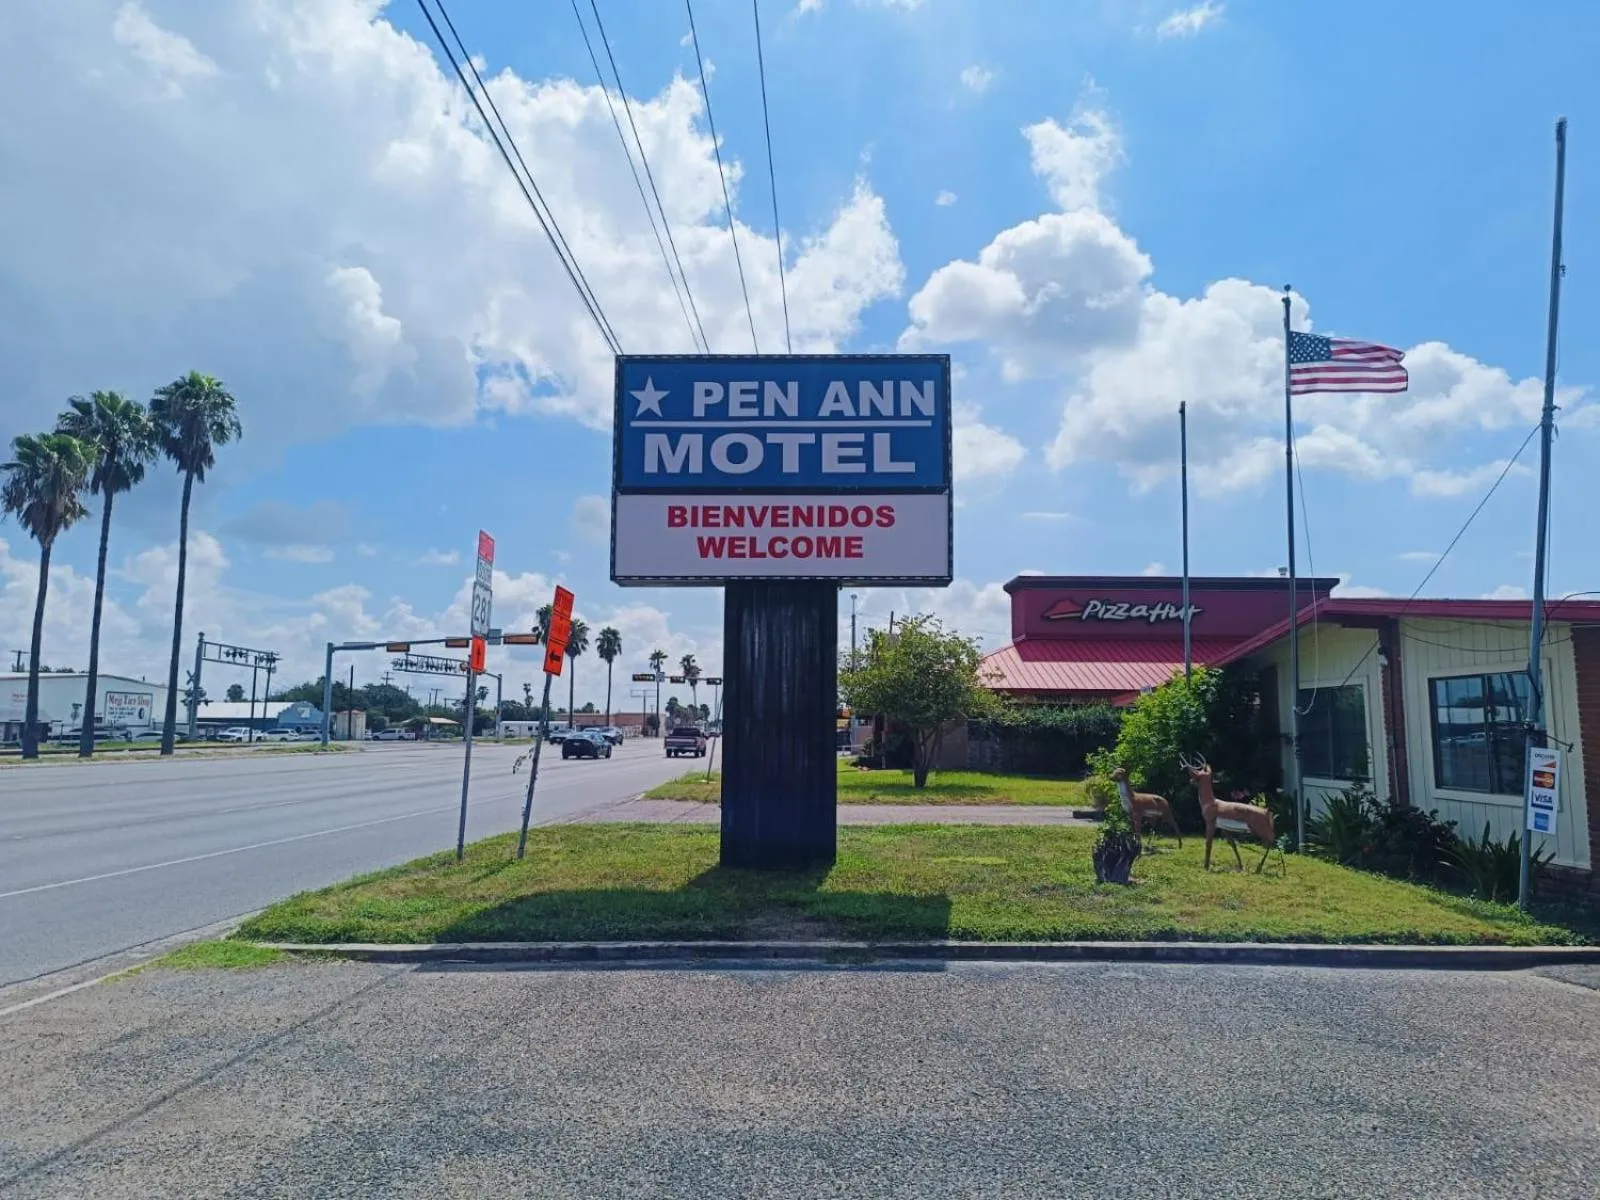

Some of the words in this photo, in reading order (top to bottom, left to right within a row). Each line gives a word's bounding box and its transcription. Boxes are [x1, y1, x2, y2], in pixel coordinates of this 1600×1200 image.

[693, 380, 799, 417] PEN
[818, 380, 935, 417] ANN
[643, 432, 916, 474] MOTEL
[667, 505, 896, 528] BIENVENIDOS
[697, 536, 864, 558] WELCOME
